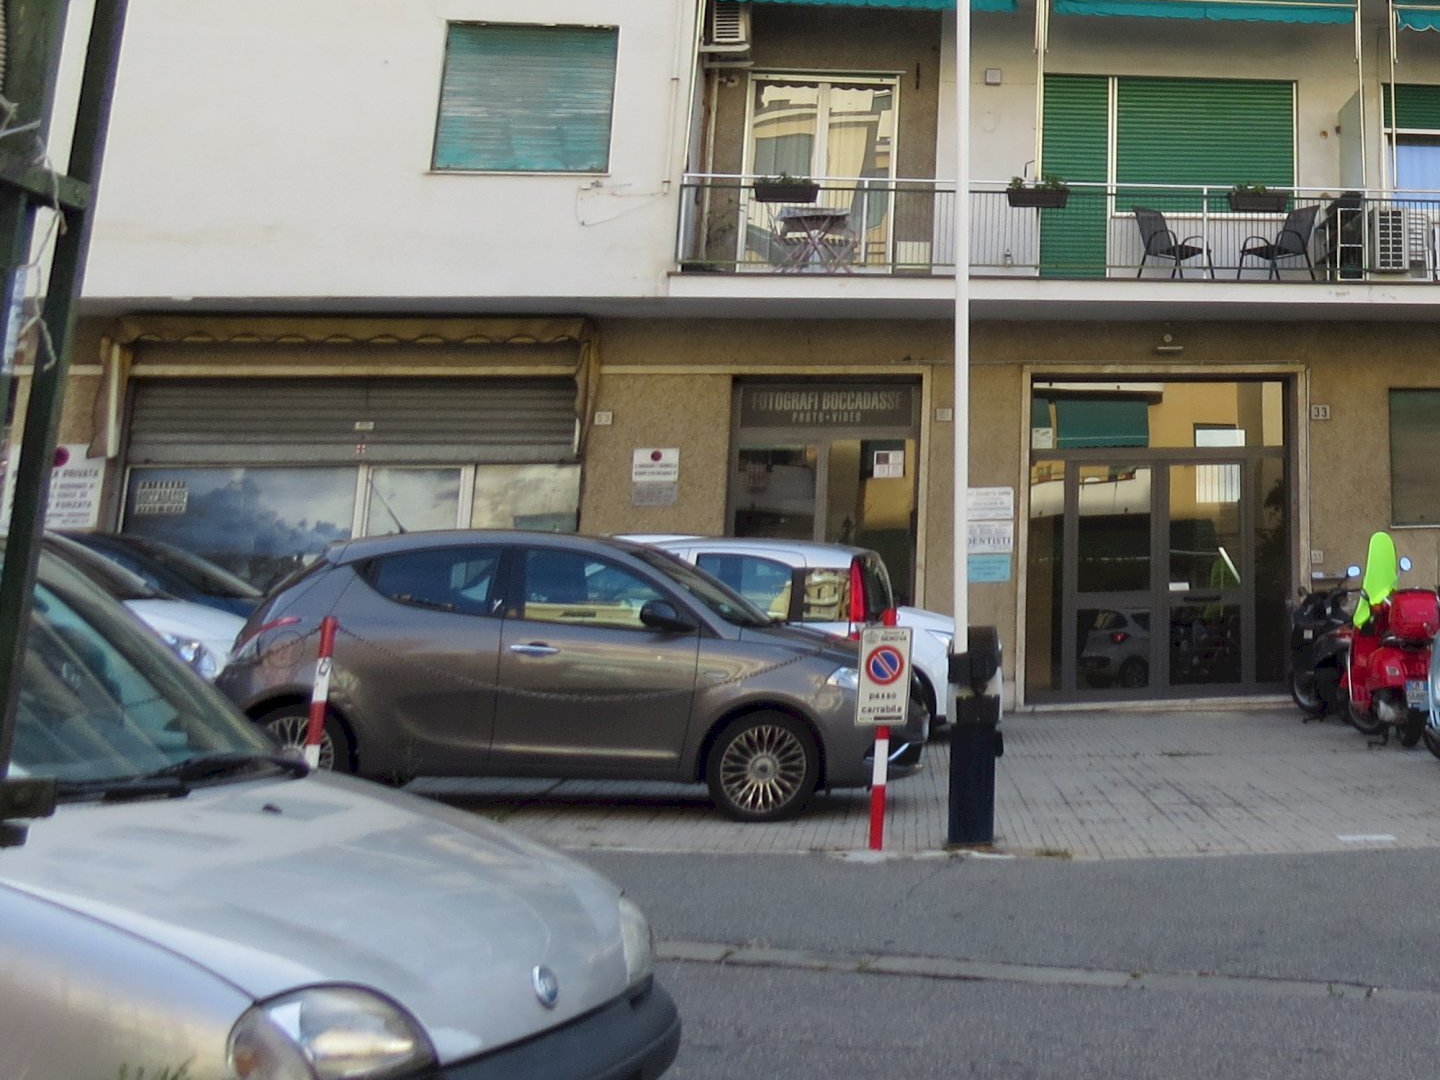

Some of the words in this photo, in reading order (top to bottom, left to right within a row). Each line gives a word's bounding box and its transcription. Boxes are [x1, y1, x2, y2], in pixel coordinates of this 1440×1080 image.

[752, 391, 819, 411] FOTOGRAFI
[822, 390, 904, 410] BOCCADASSE
[791, 411, 824, 423] PHOTO
[832, 411, 862, 422] VIDEO
[1314, 406, 1327, 418] 33
[62, 469, 99, 478] PRIVATA
[968, 537, 1011, 545] DENTISTI
[868, 692, 897, 701] passo
[861, 704, 902, 714] carrabile
